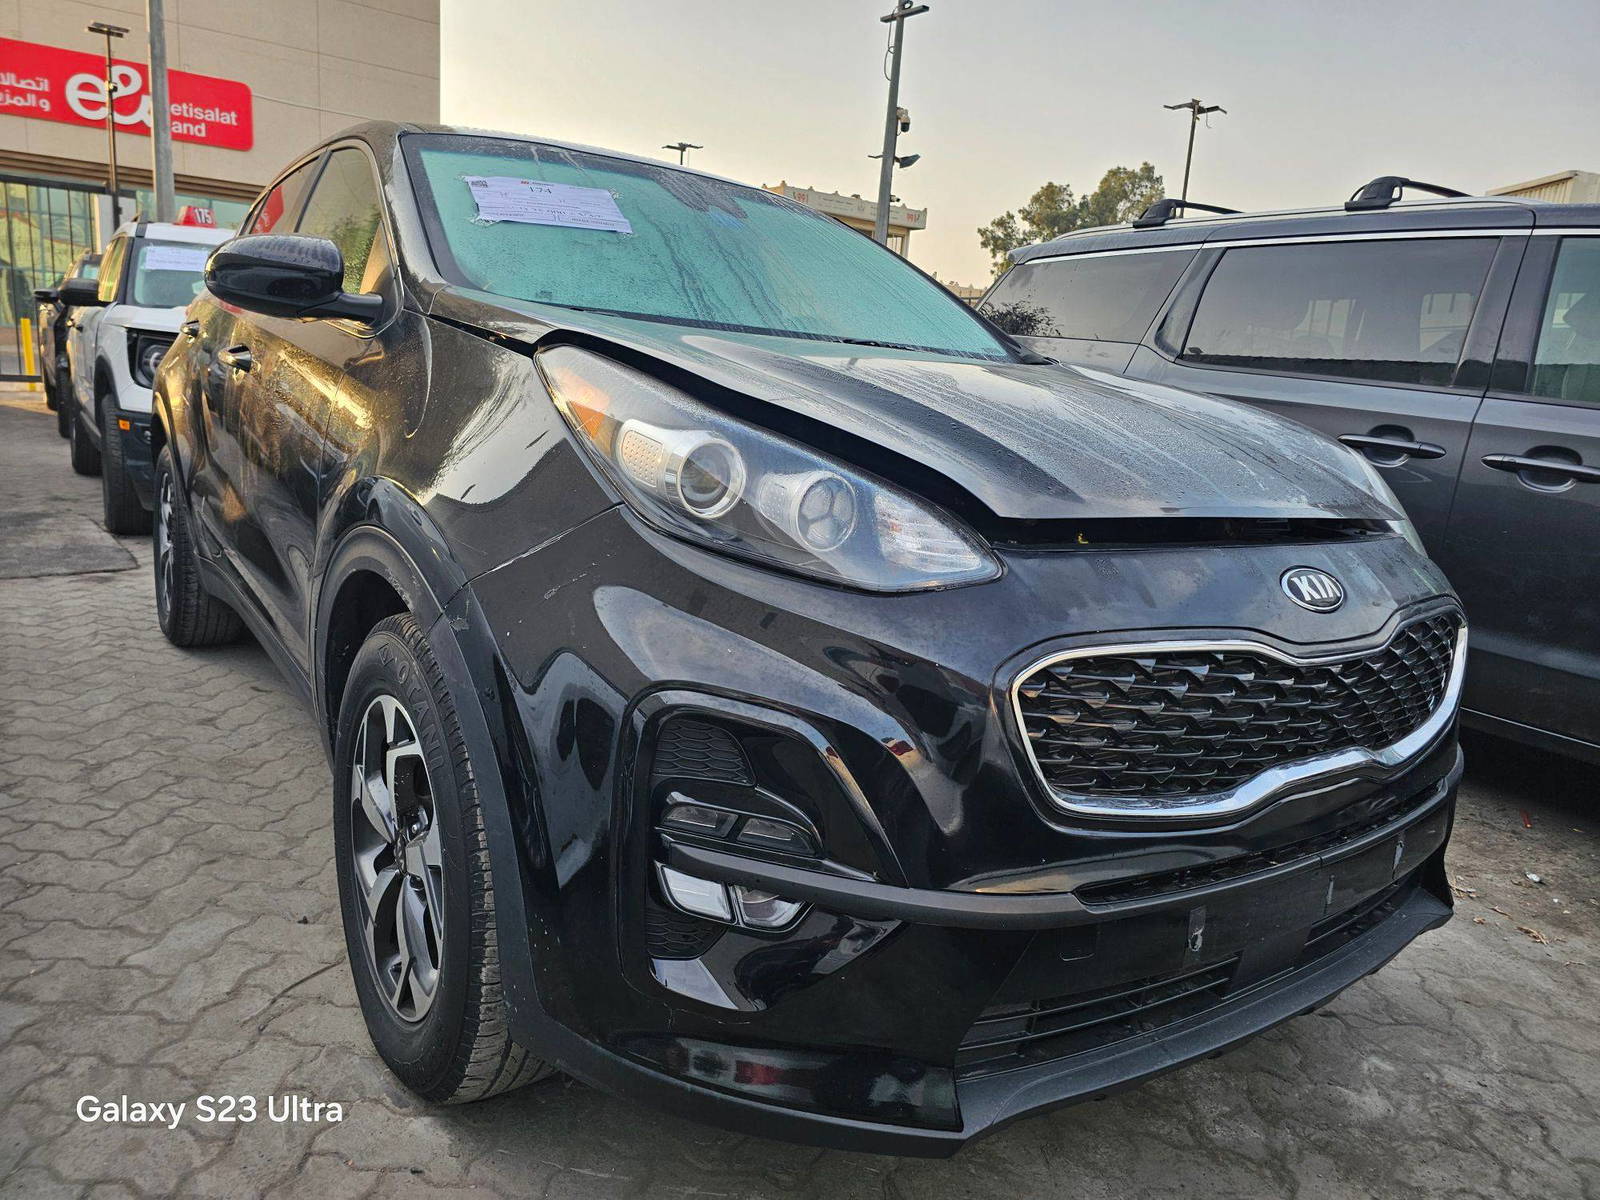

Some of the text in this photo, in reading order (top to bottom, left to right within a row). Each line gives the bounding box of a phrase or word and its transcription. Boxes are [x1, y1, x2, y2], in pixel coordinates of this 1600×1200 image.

[0, 72, 49, 92] اتصالا
[170, 102, 238, 126] etisalat
[171, 121, 207, 137] and
[195, 207, 213, 225] 175
[1290, 574, 1341, 601] KIA
